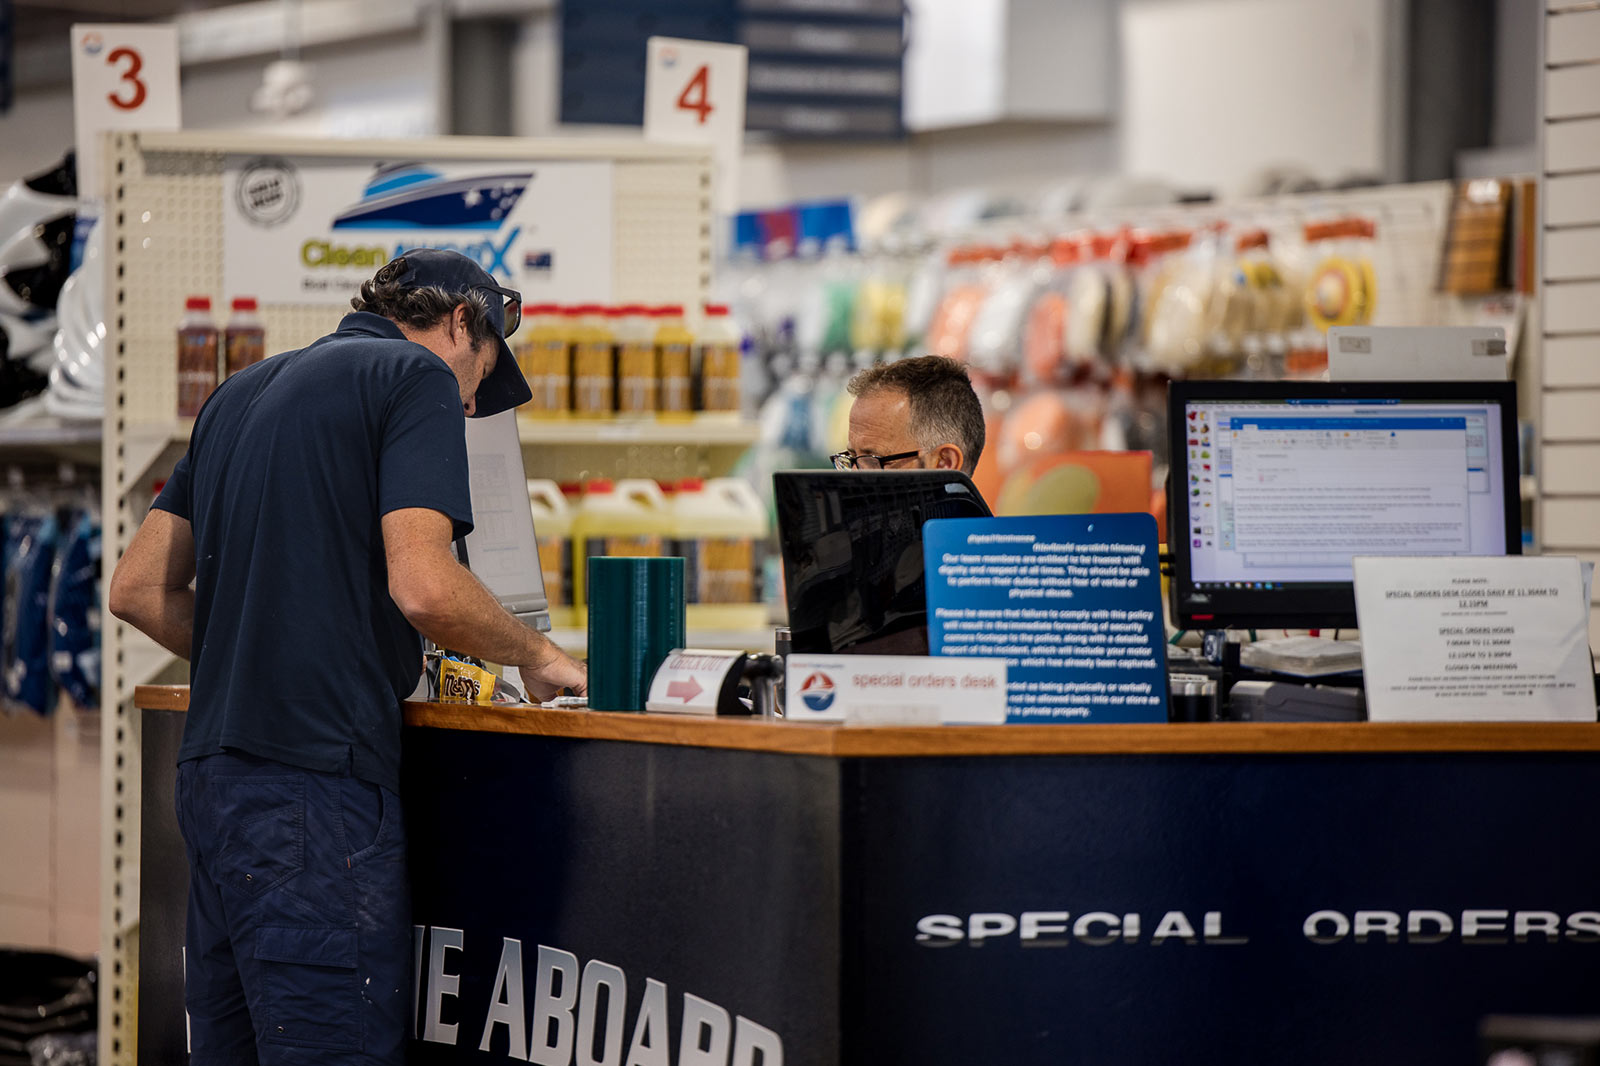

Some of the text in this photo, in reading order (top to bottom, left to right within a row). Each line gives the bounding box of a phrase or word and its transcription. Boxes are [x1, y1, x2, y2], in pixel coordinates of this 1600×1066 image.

[105, 46, 147, 111] 3
[677, 65, 713, 123] 4
[302, 240, 387, 267] Clean
[852, 672, 995, 688] special orders desk
[915, 909, 1600, 947] SPECIAL ORDERS
